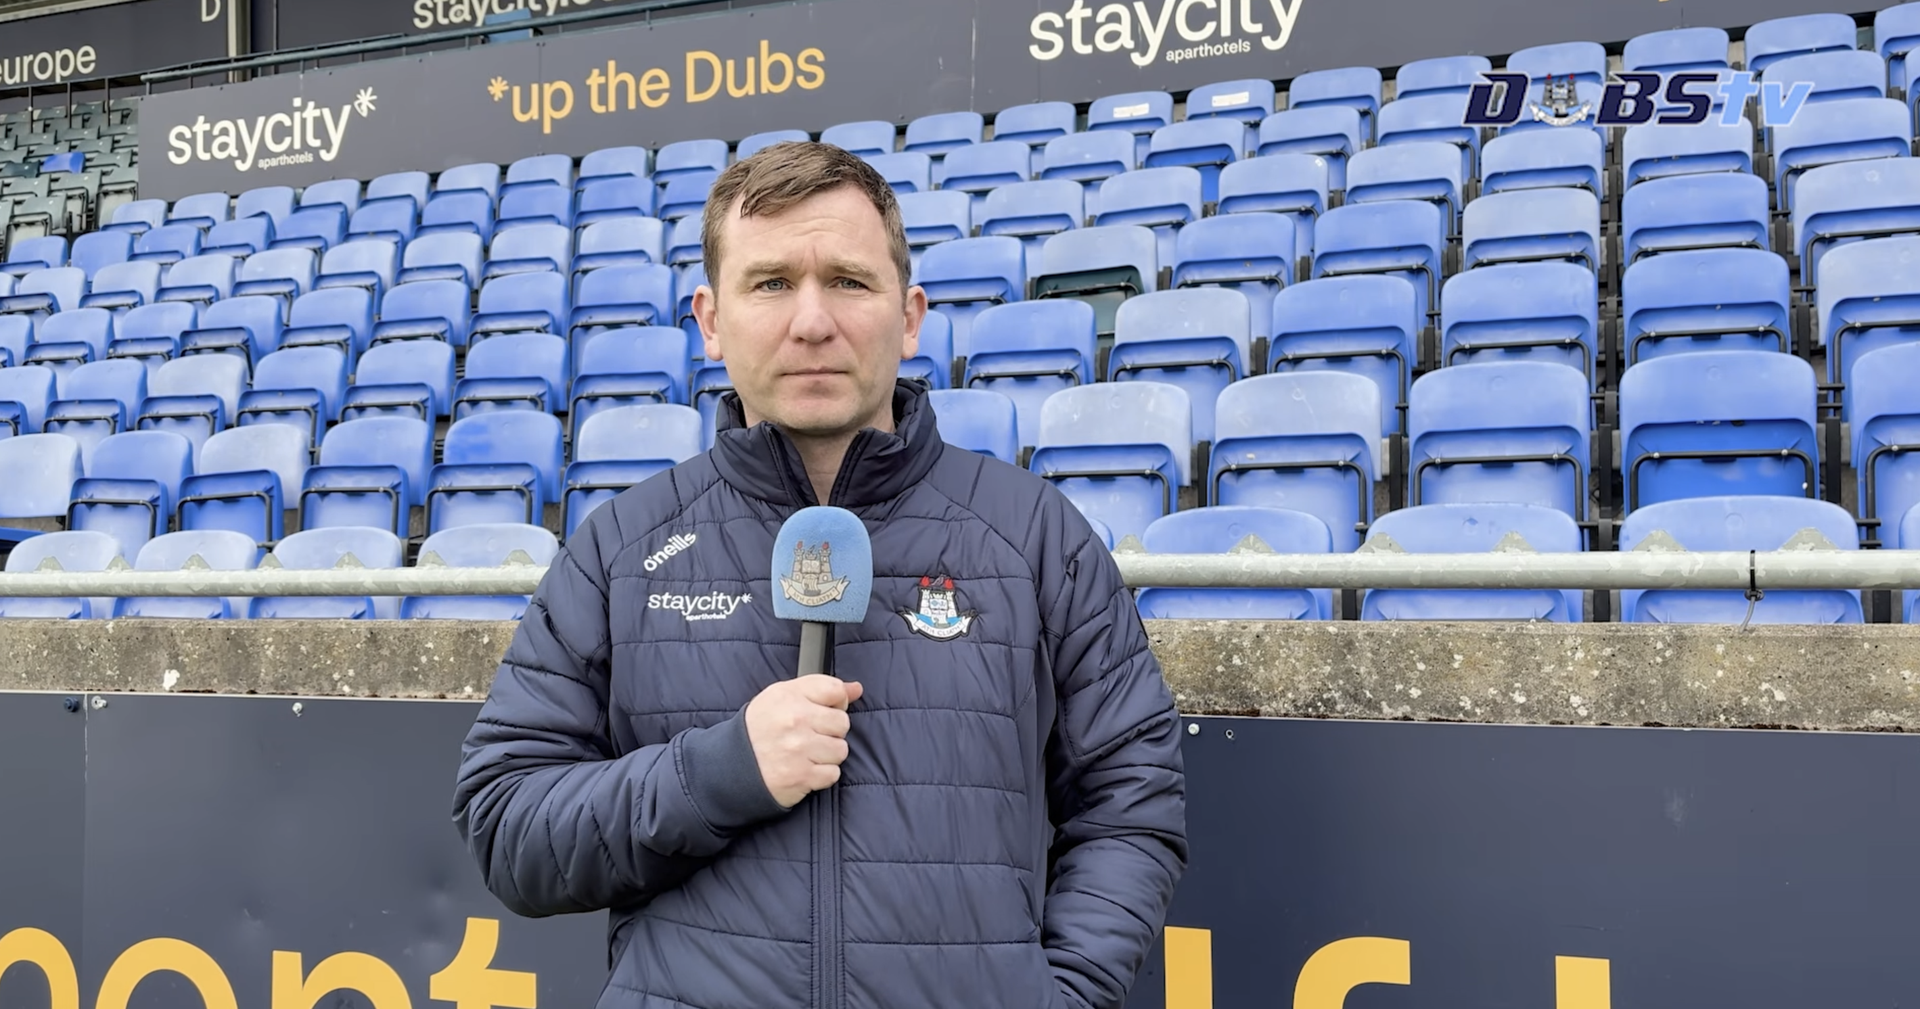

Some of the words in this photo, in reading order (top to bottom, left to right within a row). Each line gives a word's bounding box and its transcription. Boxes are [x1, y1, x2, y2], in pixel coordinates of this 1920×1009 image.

[1028, 0, 1303, 67] staycity
[1165, 38, 1251, 62] aparthotels
[0, 45, 97, 84] urope
[586, 60, 671, 113] the
[685, 40, 825, 103] Dubs
[167, 97, 352, 172] staycity
[257, 151, 314, 170] aparthotels
